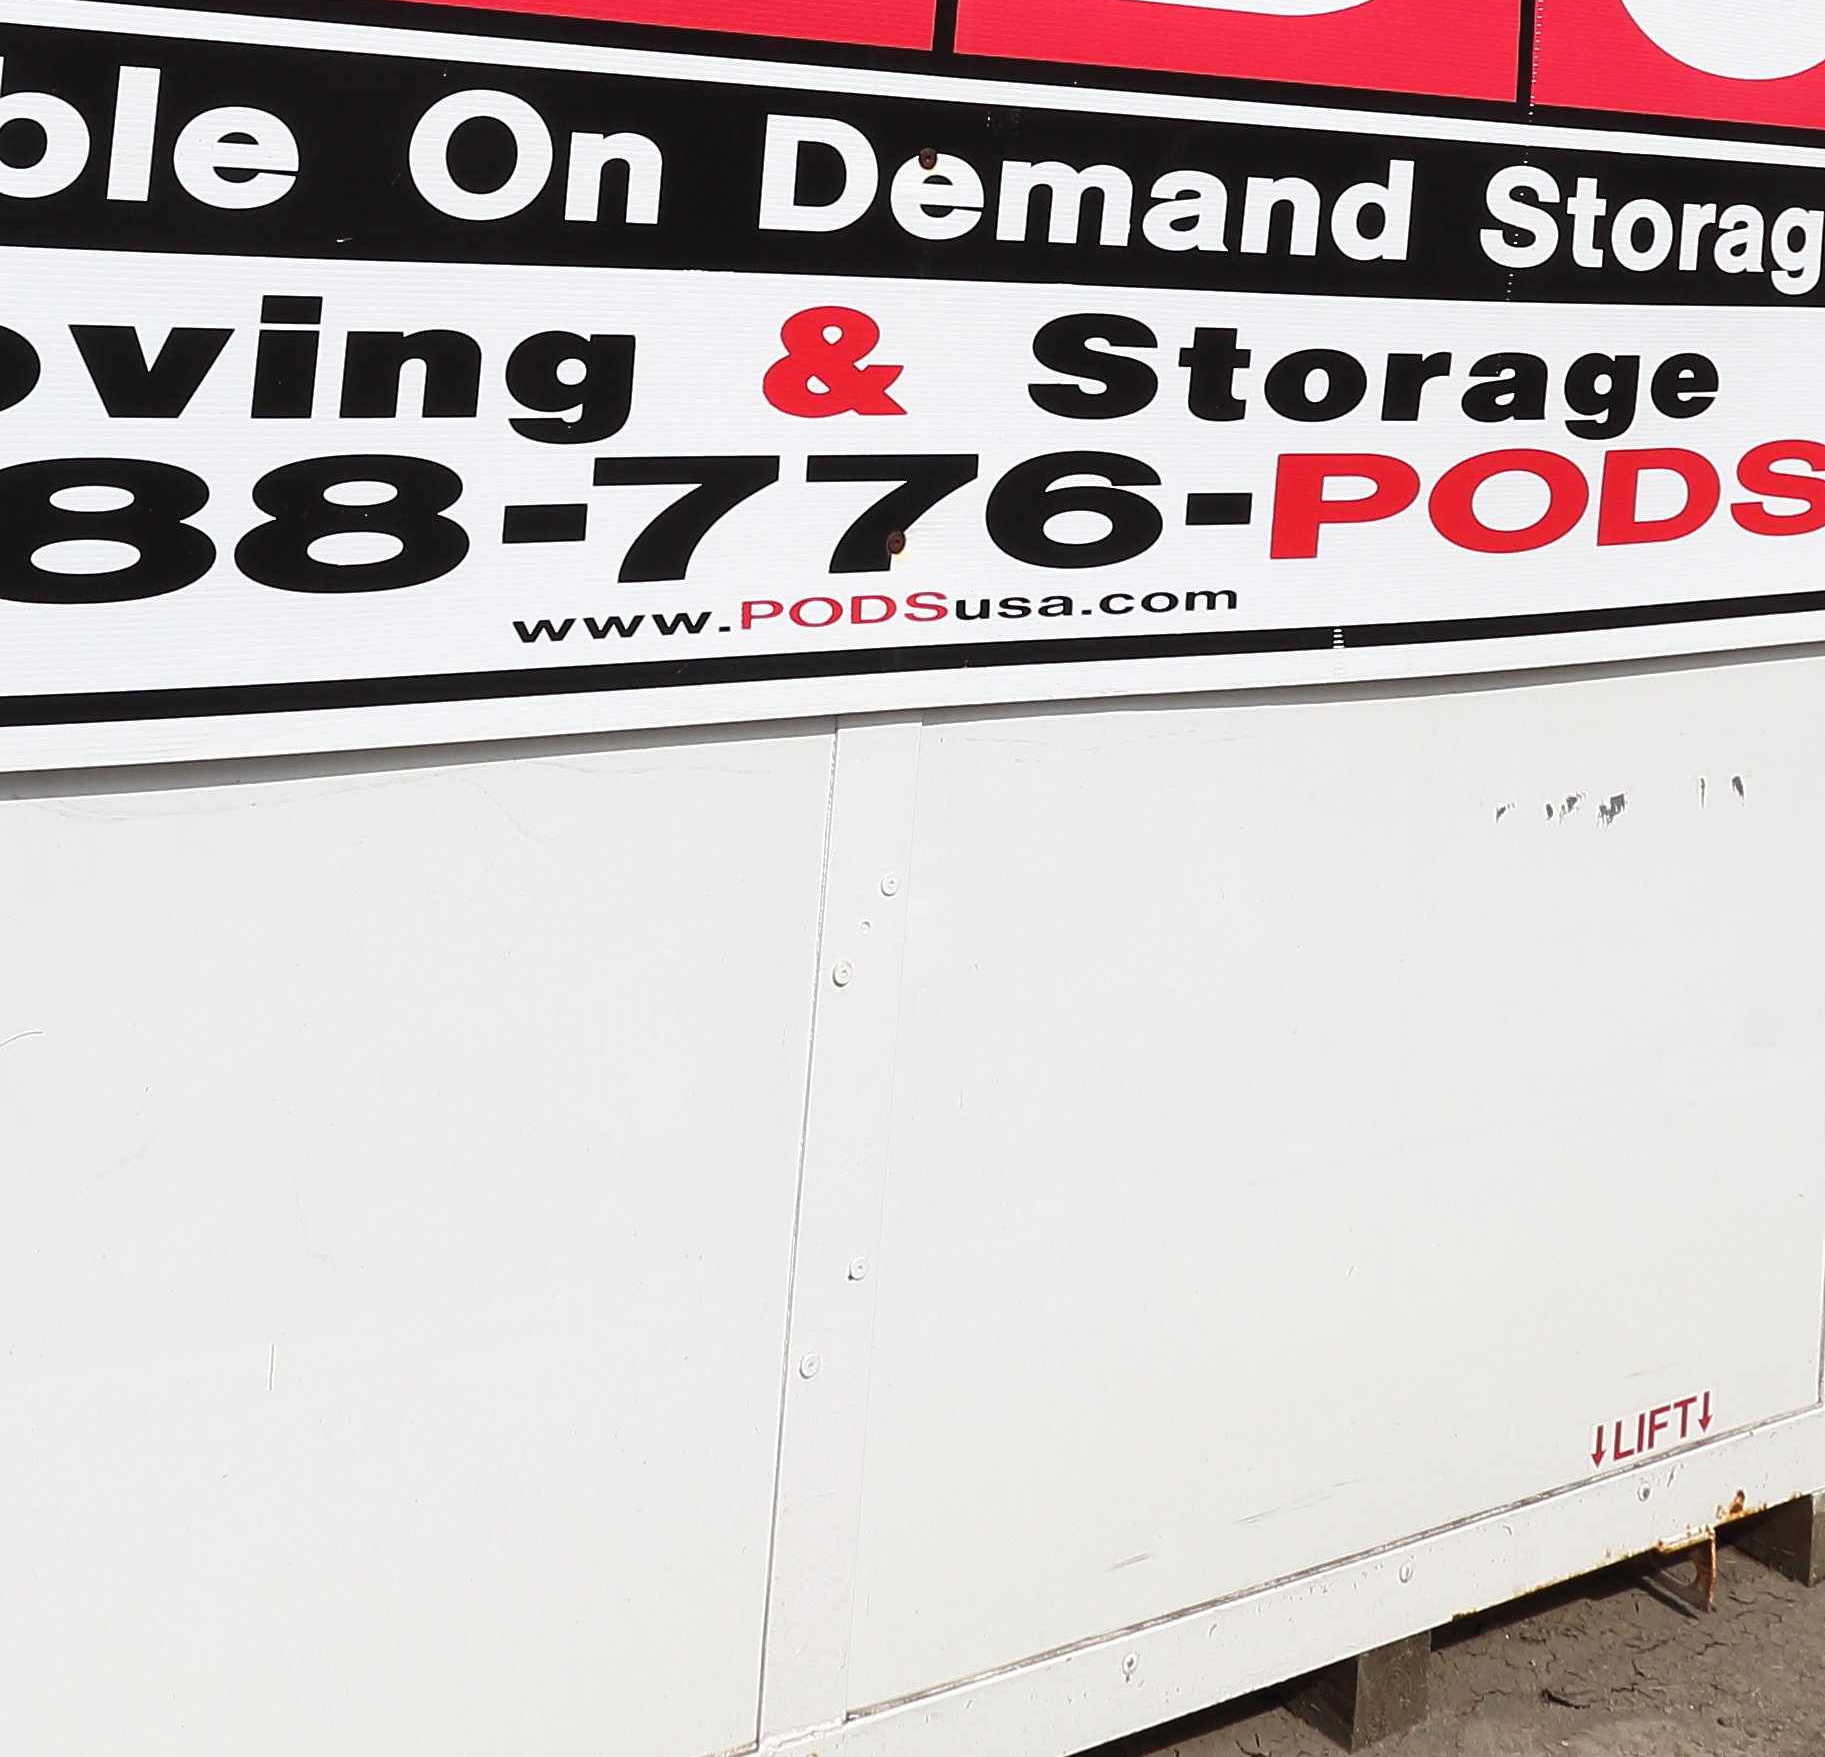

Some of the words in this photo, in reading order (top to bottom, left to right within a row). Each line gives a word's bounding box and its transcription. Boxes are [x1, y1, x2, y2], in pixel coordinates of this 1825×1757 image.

[407, 88, 663, 226] On
[757, 114, 1411, 260] Demand
[762, 305, 907, 418] &
[1027, 313, 1721, 441] Storage
[513, 582, 1239, 642] www.PODSusa.com
[1612, 1395, 1698, 1461] LIFT
